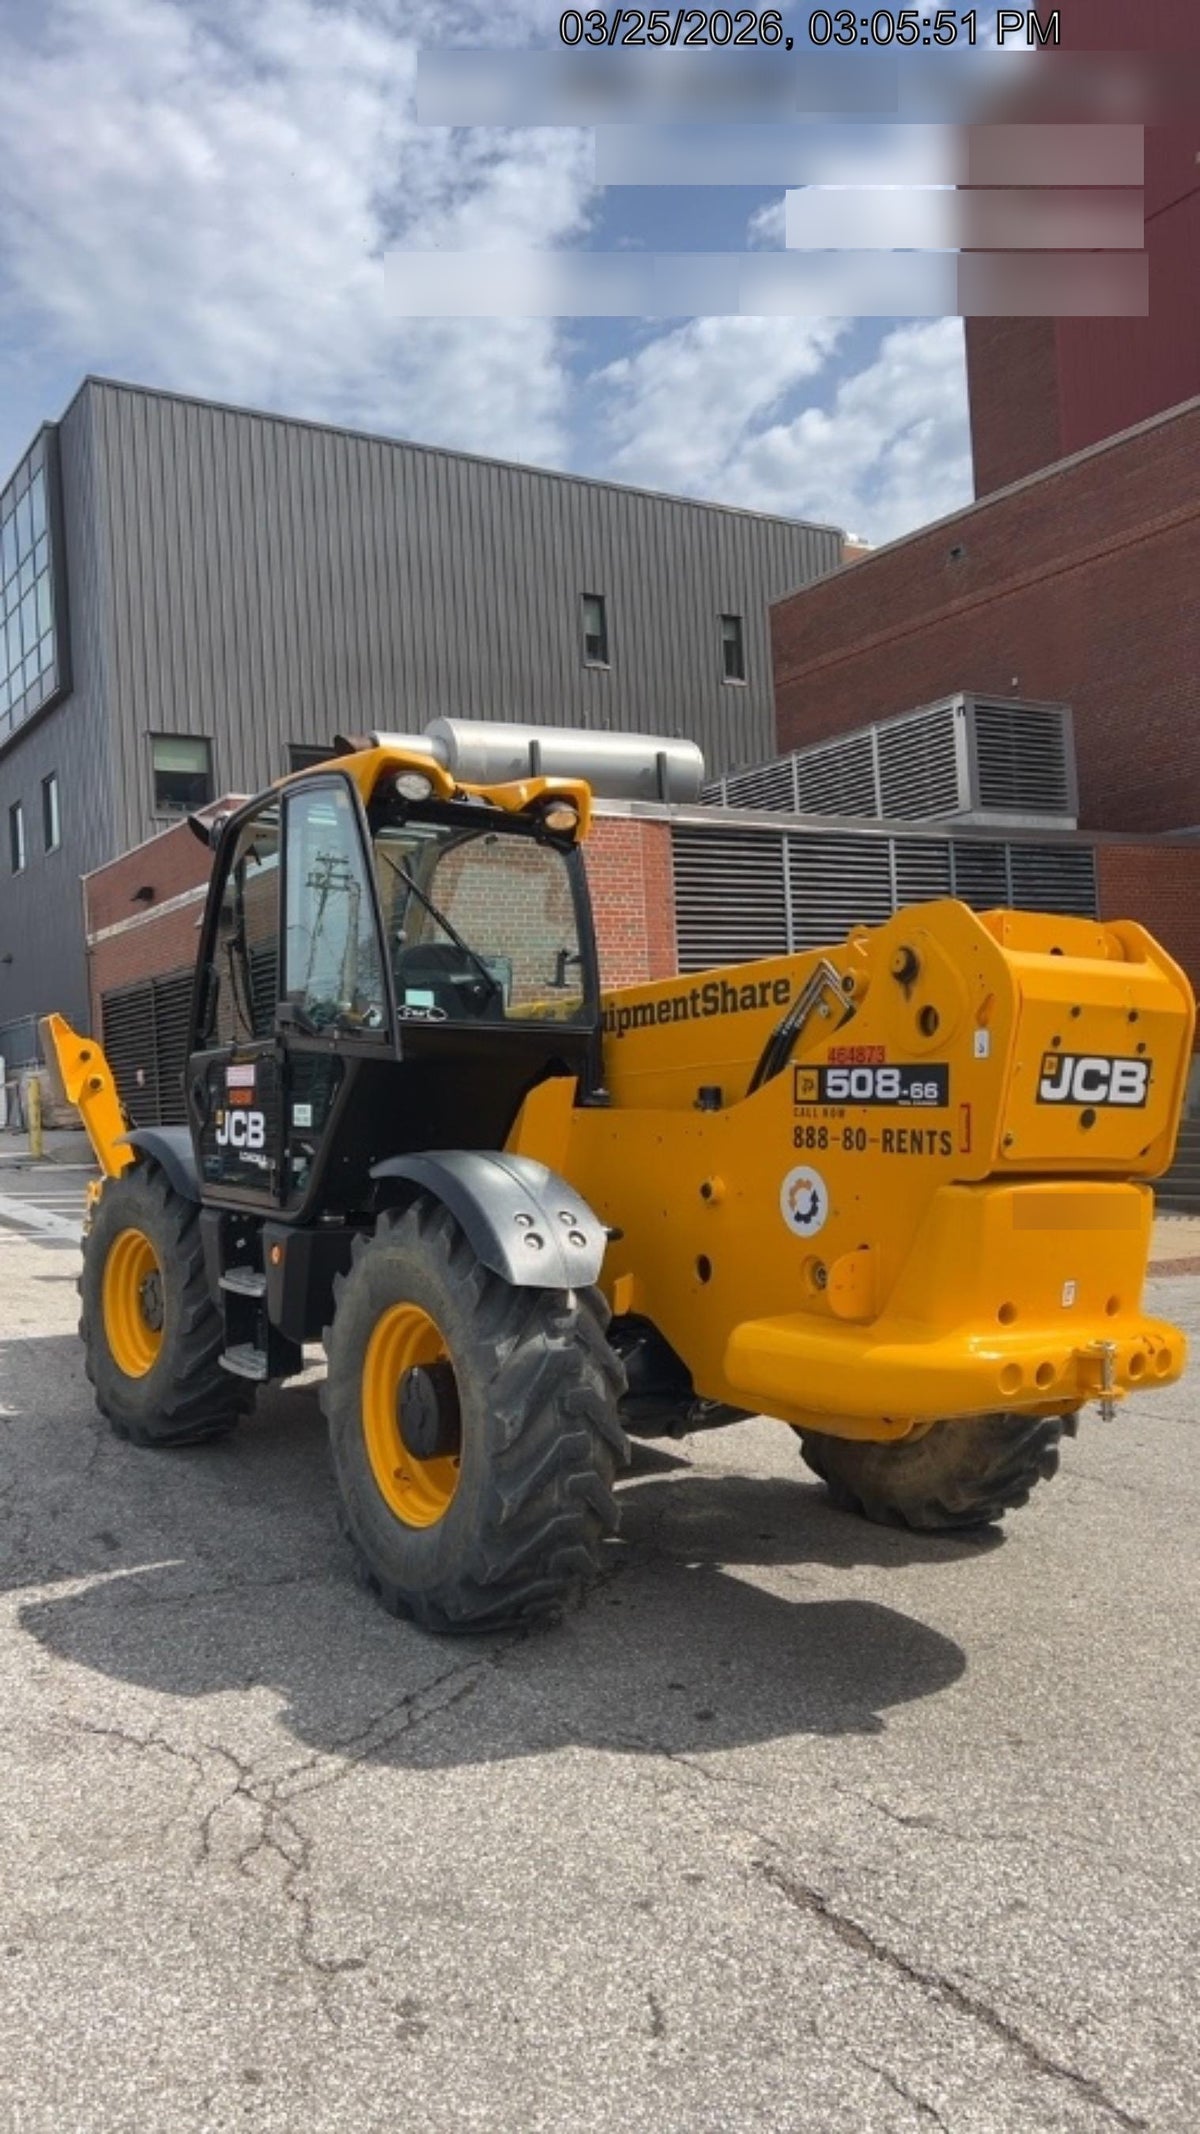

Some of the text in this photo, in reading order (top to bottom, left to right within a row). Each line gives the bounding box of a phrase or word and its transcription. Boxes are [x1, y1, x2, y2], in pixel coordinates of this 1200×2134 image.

[827, 1046, 885, 1063] 464873
[1040, 1056, 1148, 1104] JCB
[793, 1107, 818, 1118] CALL
[215, 1109, 265, 1149] JCB
[793, 1125, 952, 1156] 888-80-RENTS
